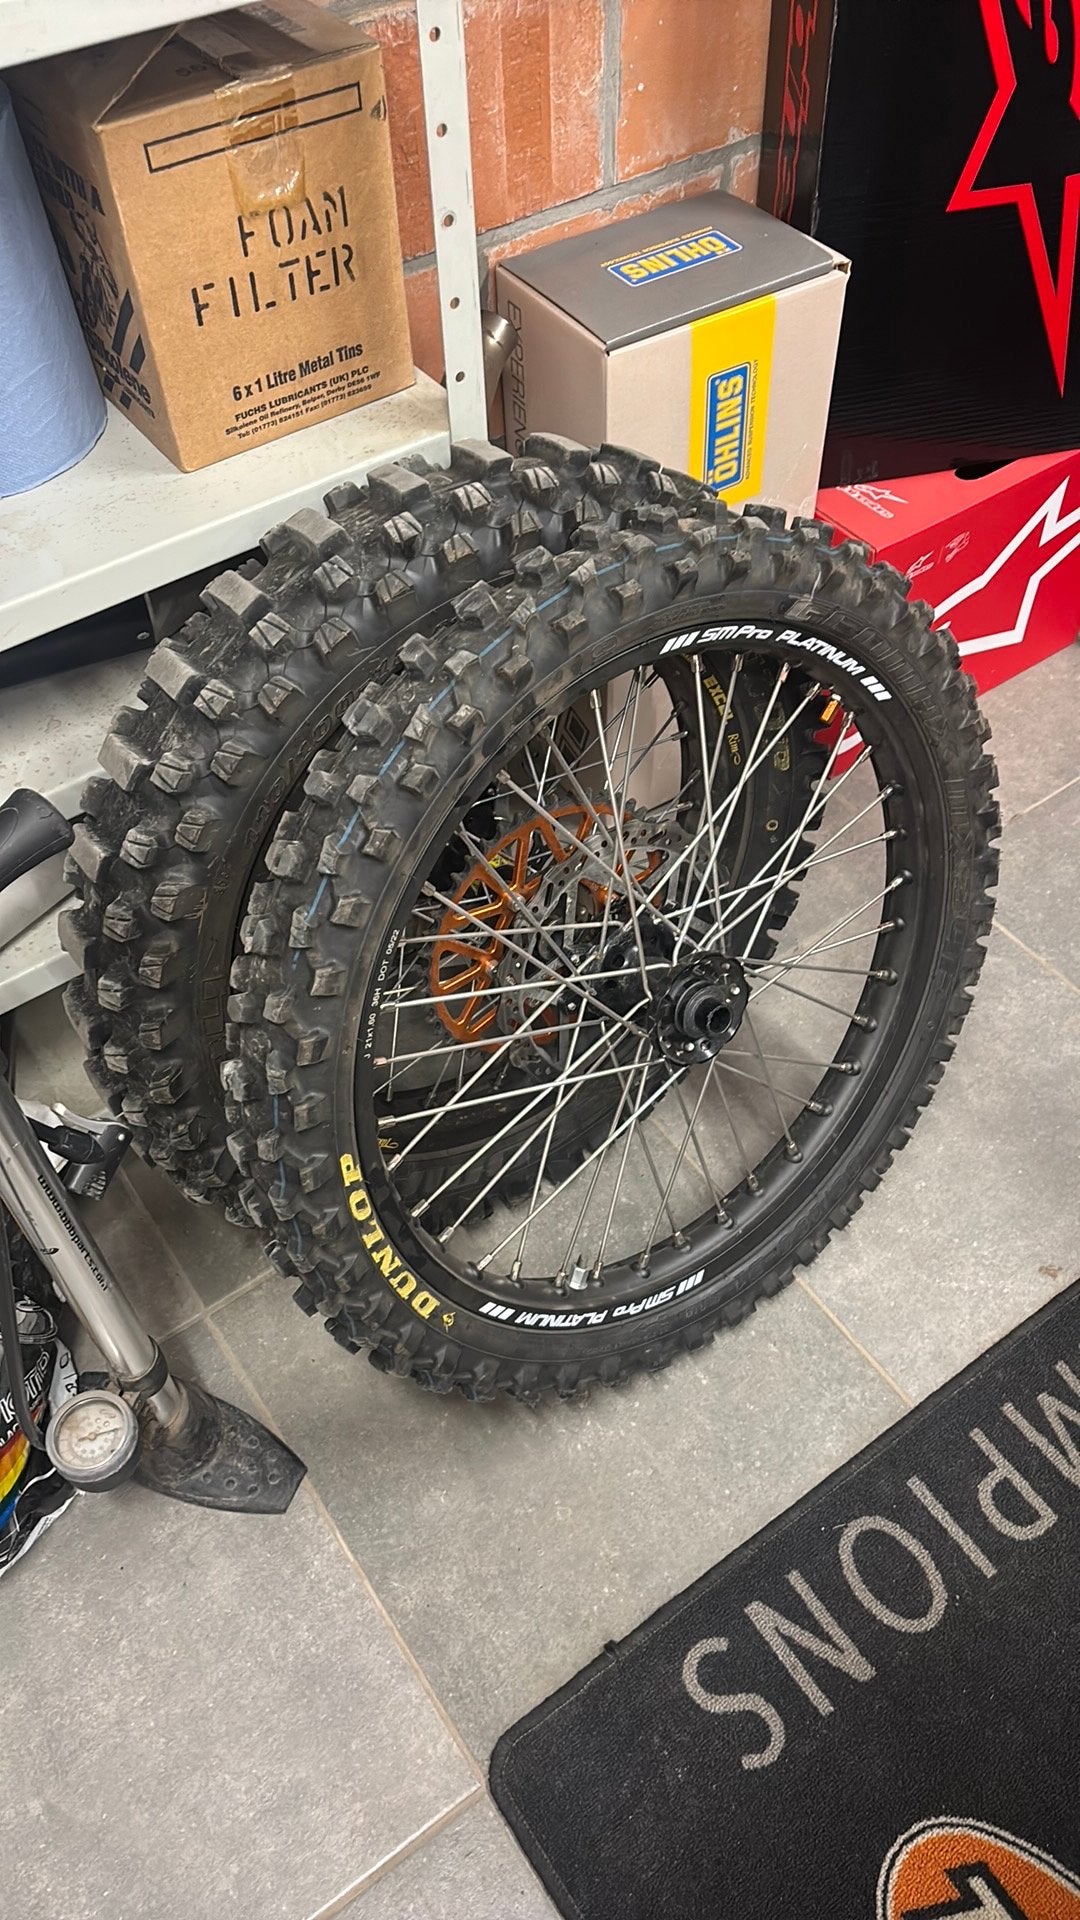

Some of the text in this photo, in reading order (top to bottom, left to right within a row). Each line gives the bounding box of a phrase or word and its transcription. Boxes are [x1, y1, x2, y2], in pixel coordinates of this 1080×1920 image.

[237, 185, 348, 257] FOAM
[191, 243, 355, 327] FILTER
[619, 236, 732, 281] ÖHLINS
[232, 343, 364, 401] 6 x 1 Litre Metal Tins
[234, 366, 369, 422] FUCHS LUBRICANTS (UK) PLC
[225, 419, 258, 435] Silkolene
[259, 412, 269, 422] Oil
[270, 403, 301, 418] Refinery,
[326, 385, 346, 398] Derby
[708, 374, 744, 486] ÖHLINS
[697, 625, 867, 676] SMPro PLATINUM
[377, 960, 390, 982] DOT
[37, 1174, 109, 1292] www.bbbparts.com
[339, 1153, 441, 1320] DUNLOP
[515, 1311, 610, 1327] PLATINUM
[612, 1285, 677, 1317] SMPro
